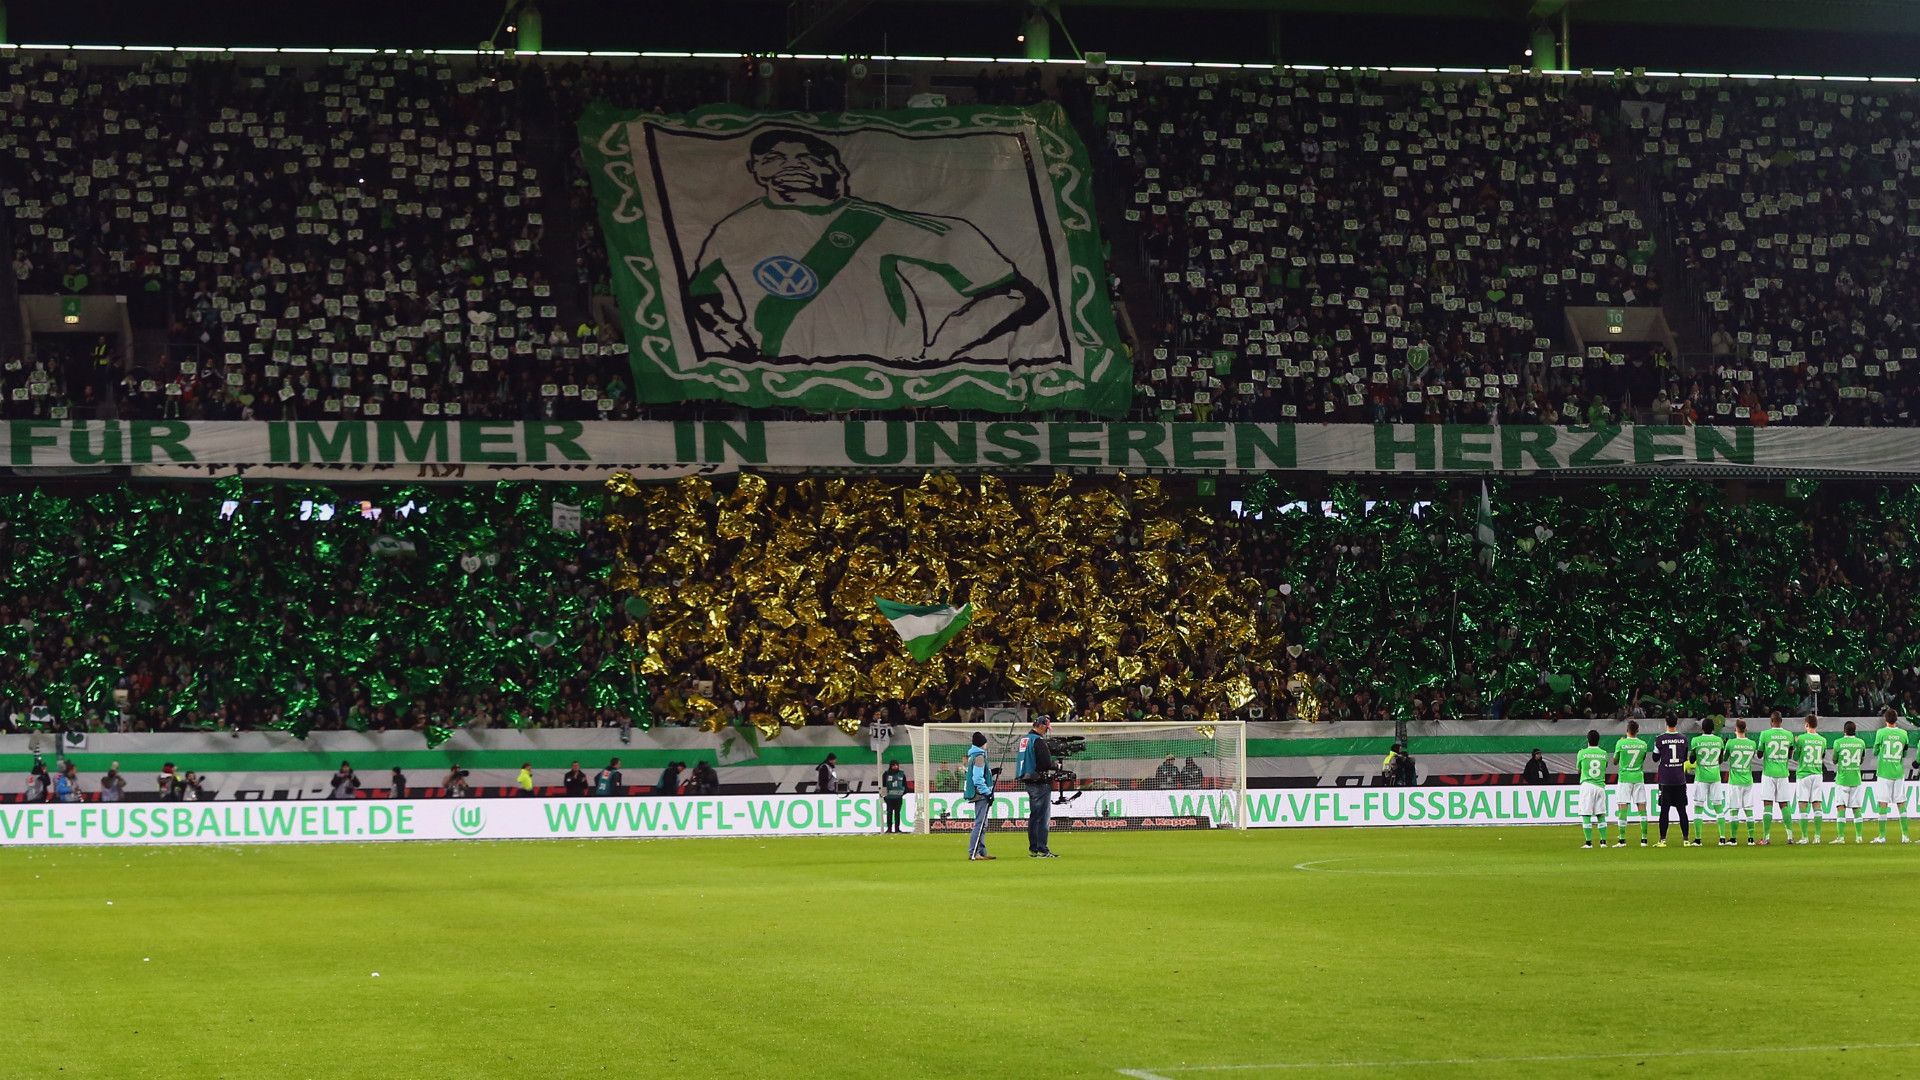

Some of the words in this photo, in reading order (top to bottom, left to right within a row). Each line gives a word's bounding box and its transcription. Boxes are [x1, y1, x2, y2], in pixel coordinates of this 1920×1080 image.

[268, 421, 592, 463] IMMER
[674, 420, 768, 463] IN
[844, 421, 1297, 469] UNSEREN
[1374, 425, 1755, 470] HERZEN
[873, 728, 887, 739] 19
[1626, 749, 1640, 768] 7
[1669, 744, 1680, 763] 1
[1697, 747, 1721, 766] 22
[1730, 750, 1754, 769] 27
[1767, 741, 1789, 759] 25
[1803, 745, 1822, 764] 31
[1840, 748, 1861, 767] 34
[1883, 740, 1903, 760] 12
[1588, 759, 1601, 778] 8
[0, 804, 415, 839] VFL-FUSSBALLWELT.DE
[1087, 819, 1128, 828] Kappa
[1155, 818, 1197, 827] Kappa
